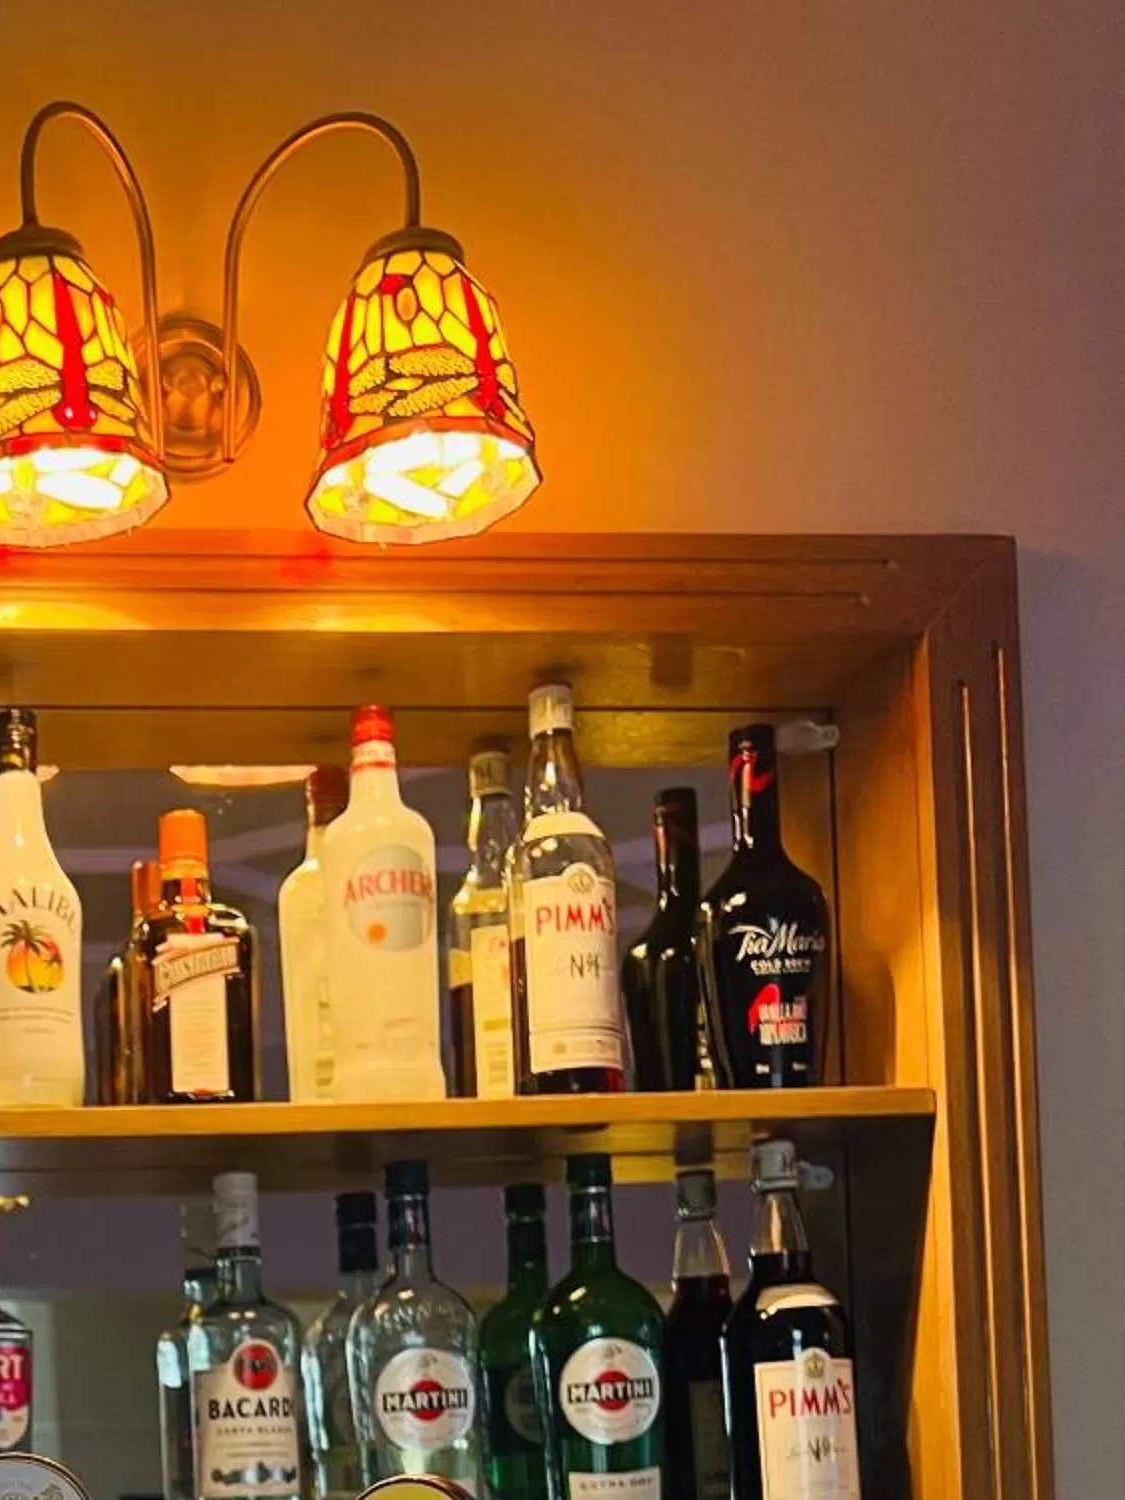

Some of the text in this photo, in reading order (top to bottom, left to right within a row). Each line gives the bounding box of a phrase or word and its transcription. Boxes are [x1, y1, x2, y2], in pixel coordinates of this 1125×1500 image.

[385, 1389, 467, 1411] MARTINI
[569, 1379, 651, 1403] MARTINI
[768, 1377, 852, 1420] PIMM'S
[207, 1398, 293, 1420] BACARD
